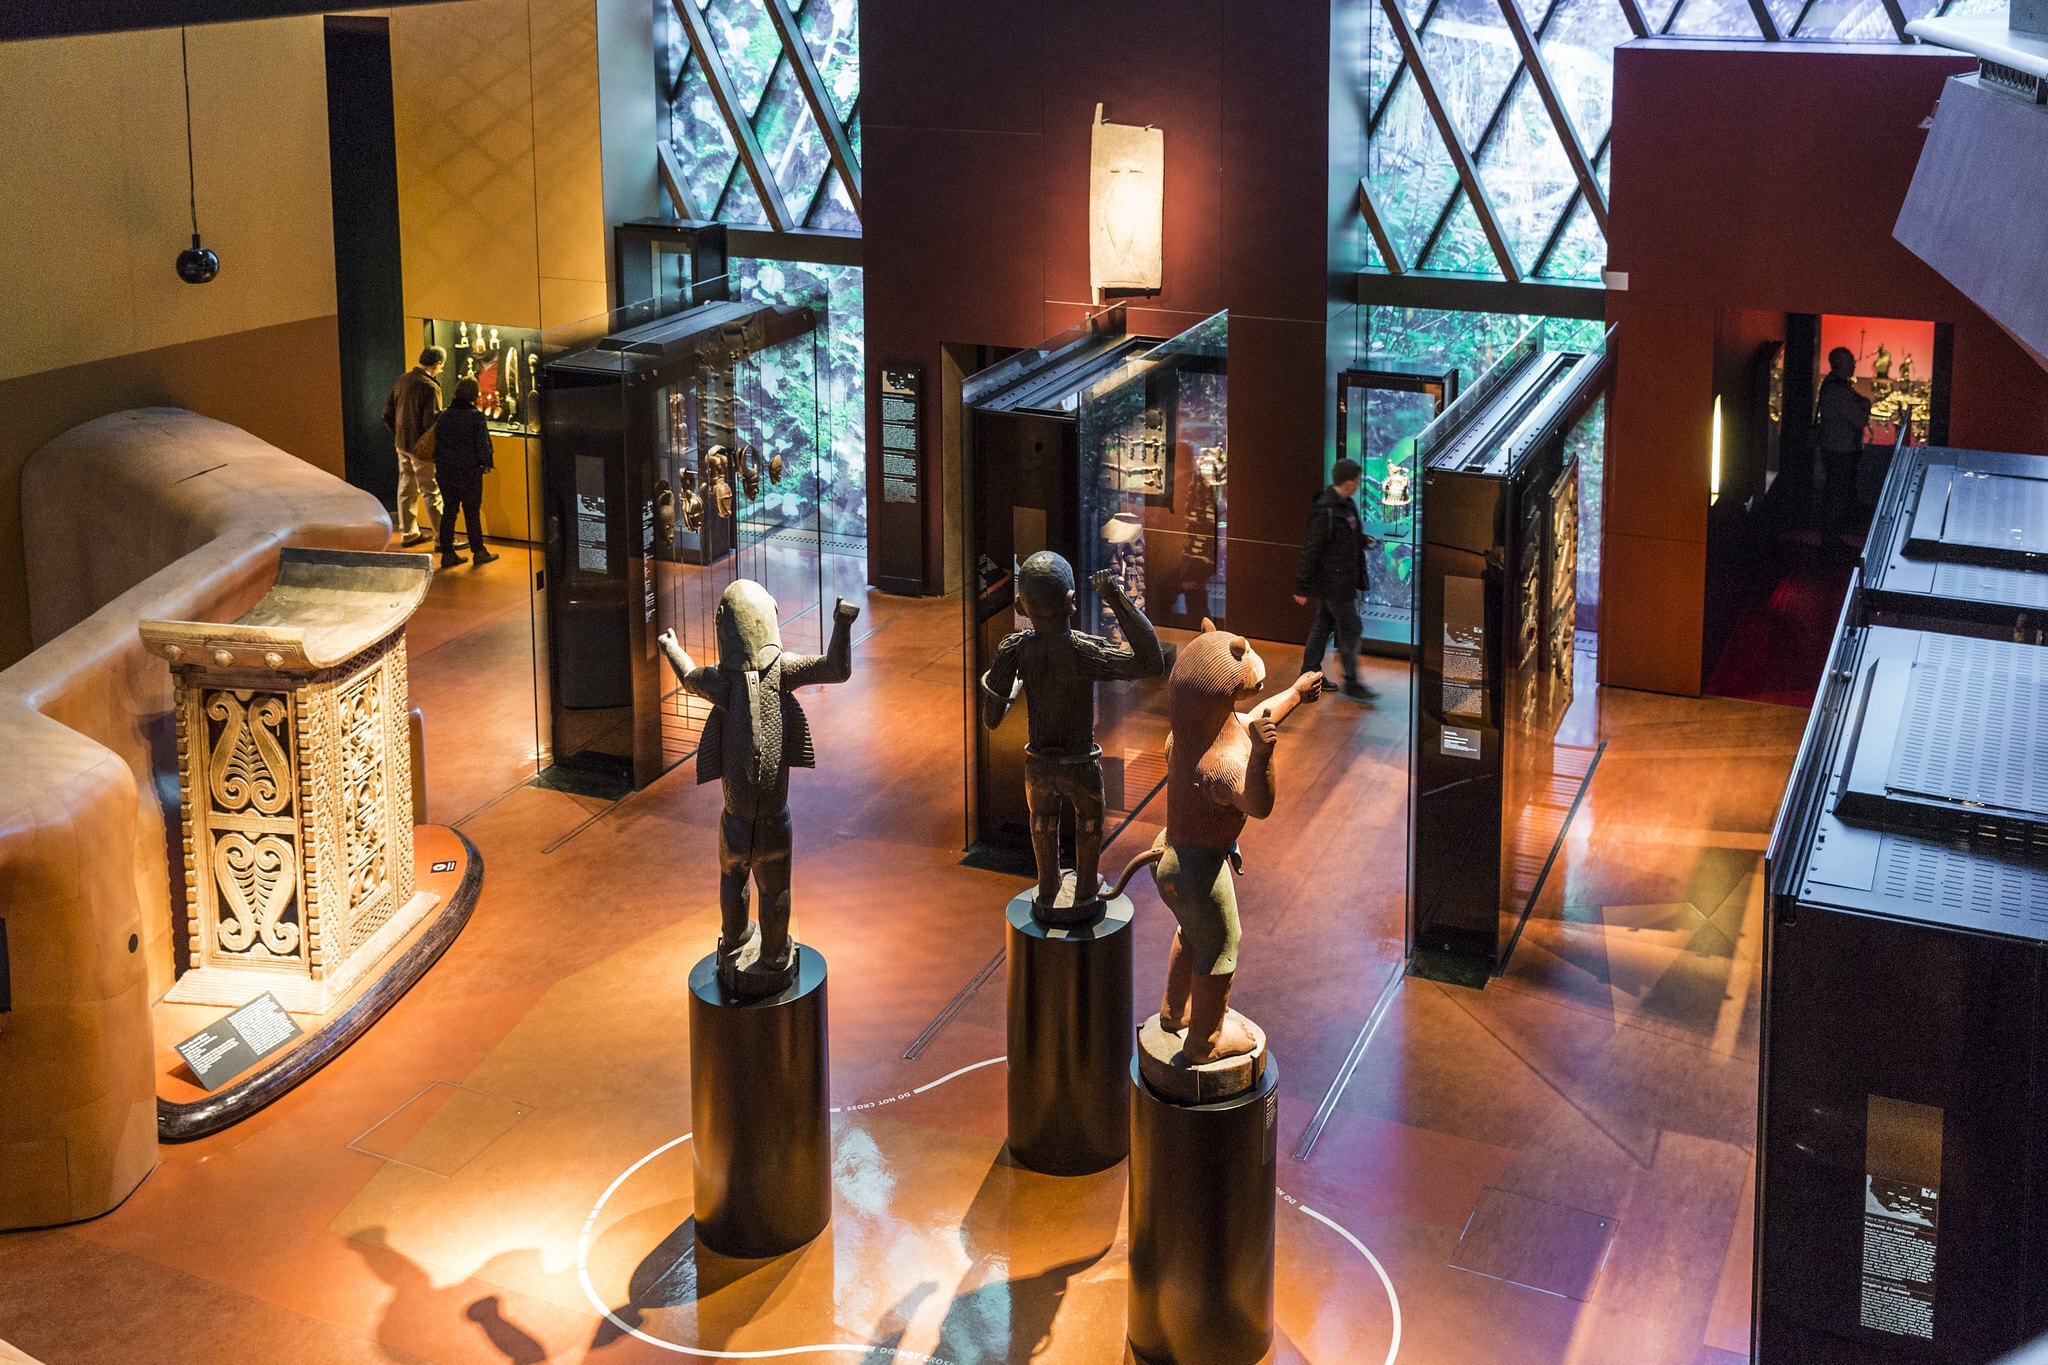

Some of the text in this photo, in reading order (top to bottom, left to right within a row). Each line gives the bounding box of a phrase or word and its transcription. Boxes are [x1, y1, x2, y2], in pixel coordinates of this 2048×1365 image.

[878, 1097, 896, 1105] NOT
[846, 1102, 875, 1111] CROSS
[1283, 1195, 1297, 1204] DO
[880, 1347, 896, 1355] DO
[899, 1350, 920, 1359] NOT
